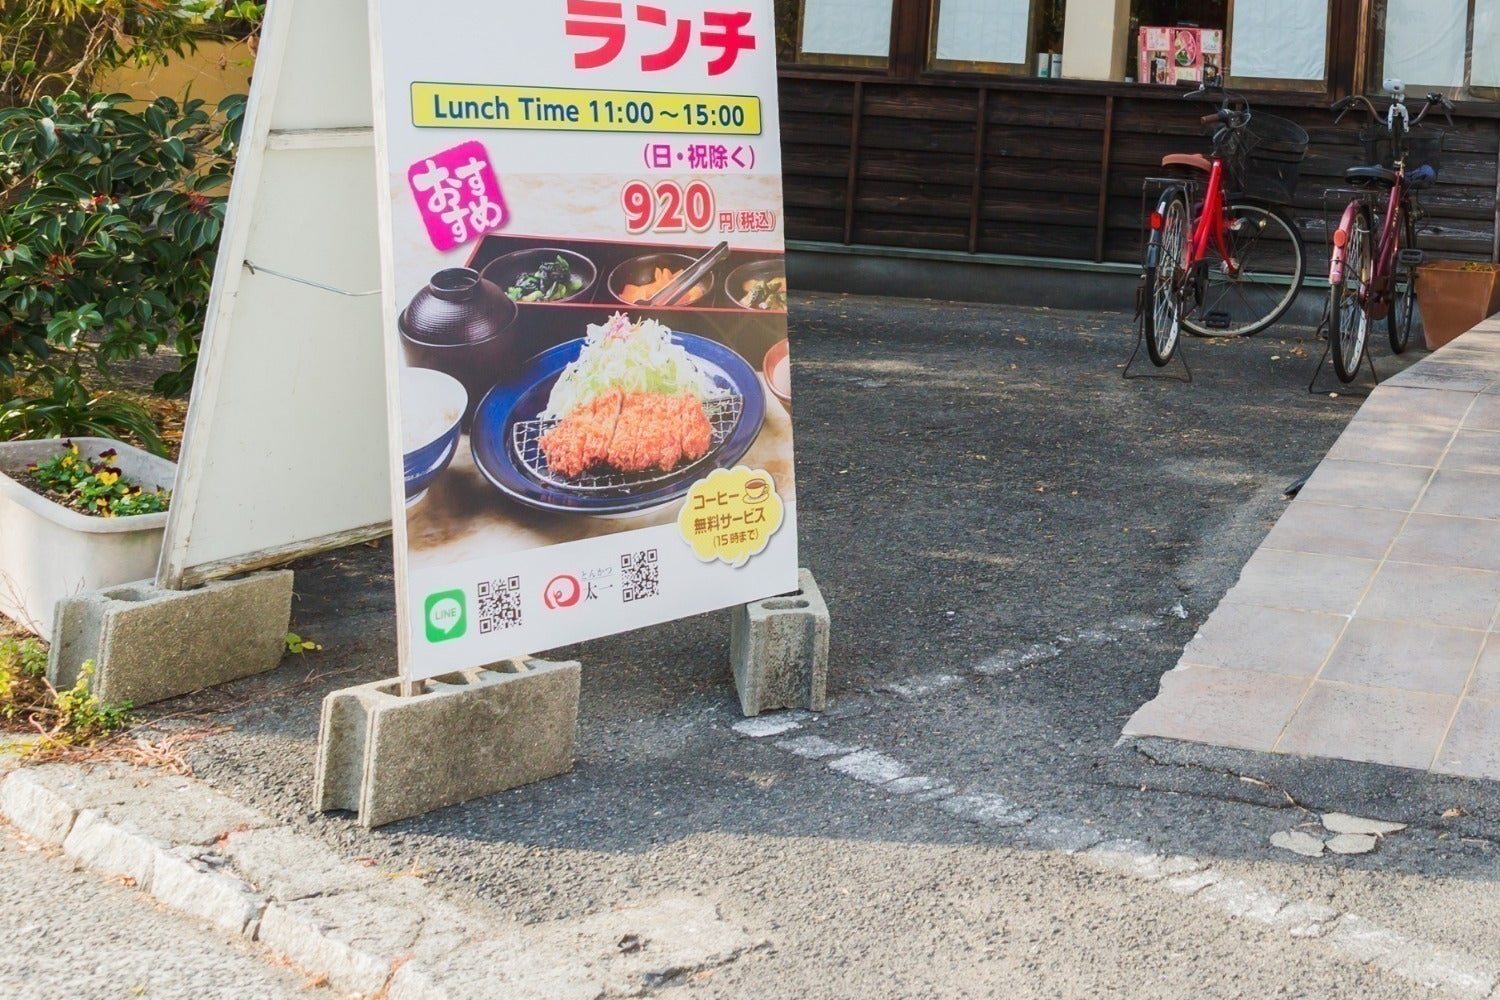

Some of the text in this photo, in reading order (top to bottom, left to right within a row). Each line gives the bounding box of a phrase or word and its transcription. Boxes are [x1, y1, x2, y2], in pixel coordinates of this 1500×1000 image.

[433, 94, 509, 120] Lunch
[518, 96, 579, 122] Time
[693, 491, 740, 510] コーヒー
[693, 507, 766, 535] 無料サービス
[583, 581, 614, 601] 太一
[435, 608, 457, 621] LINE
